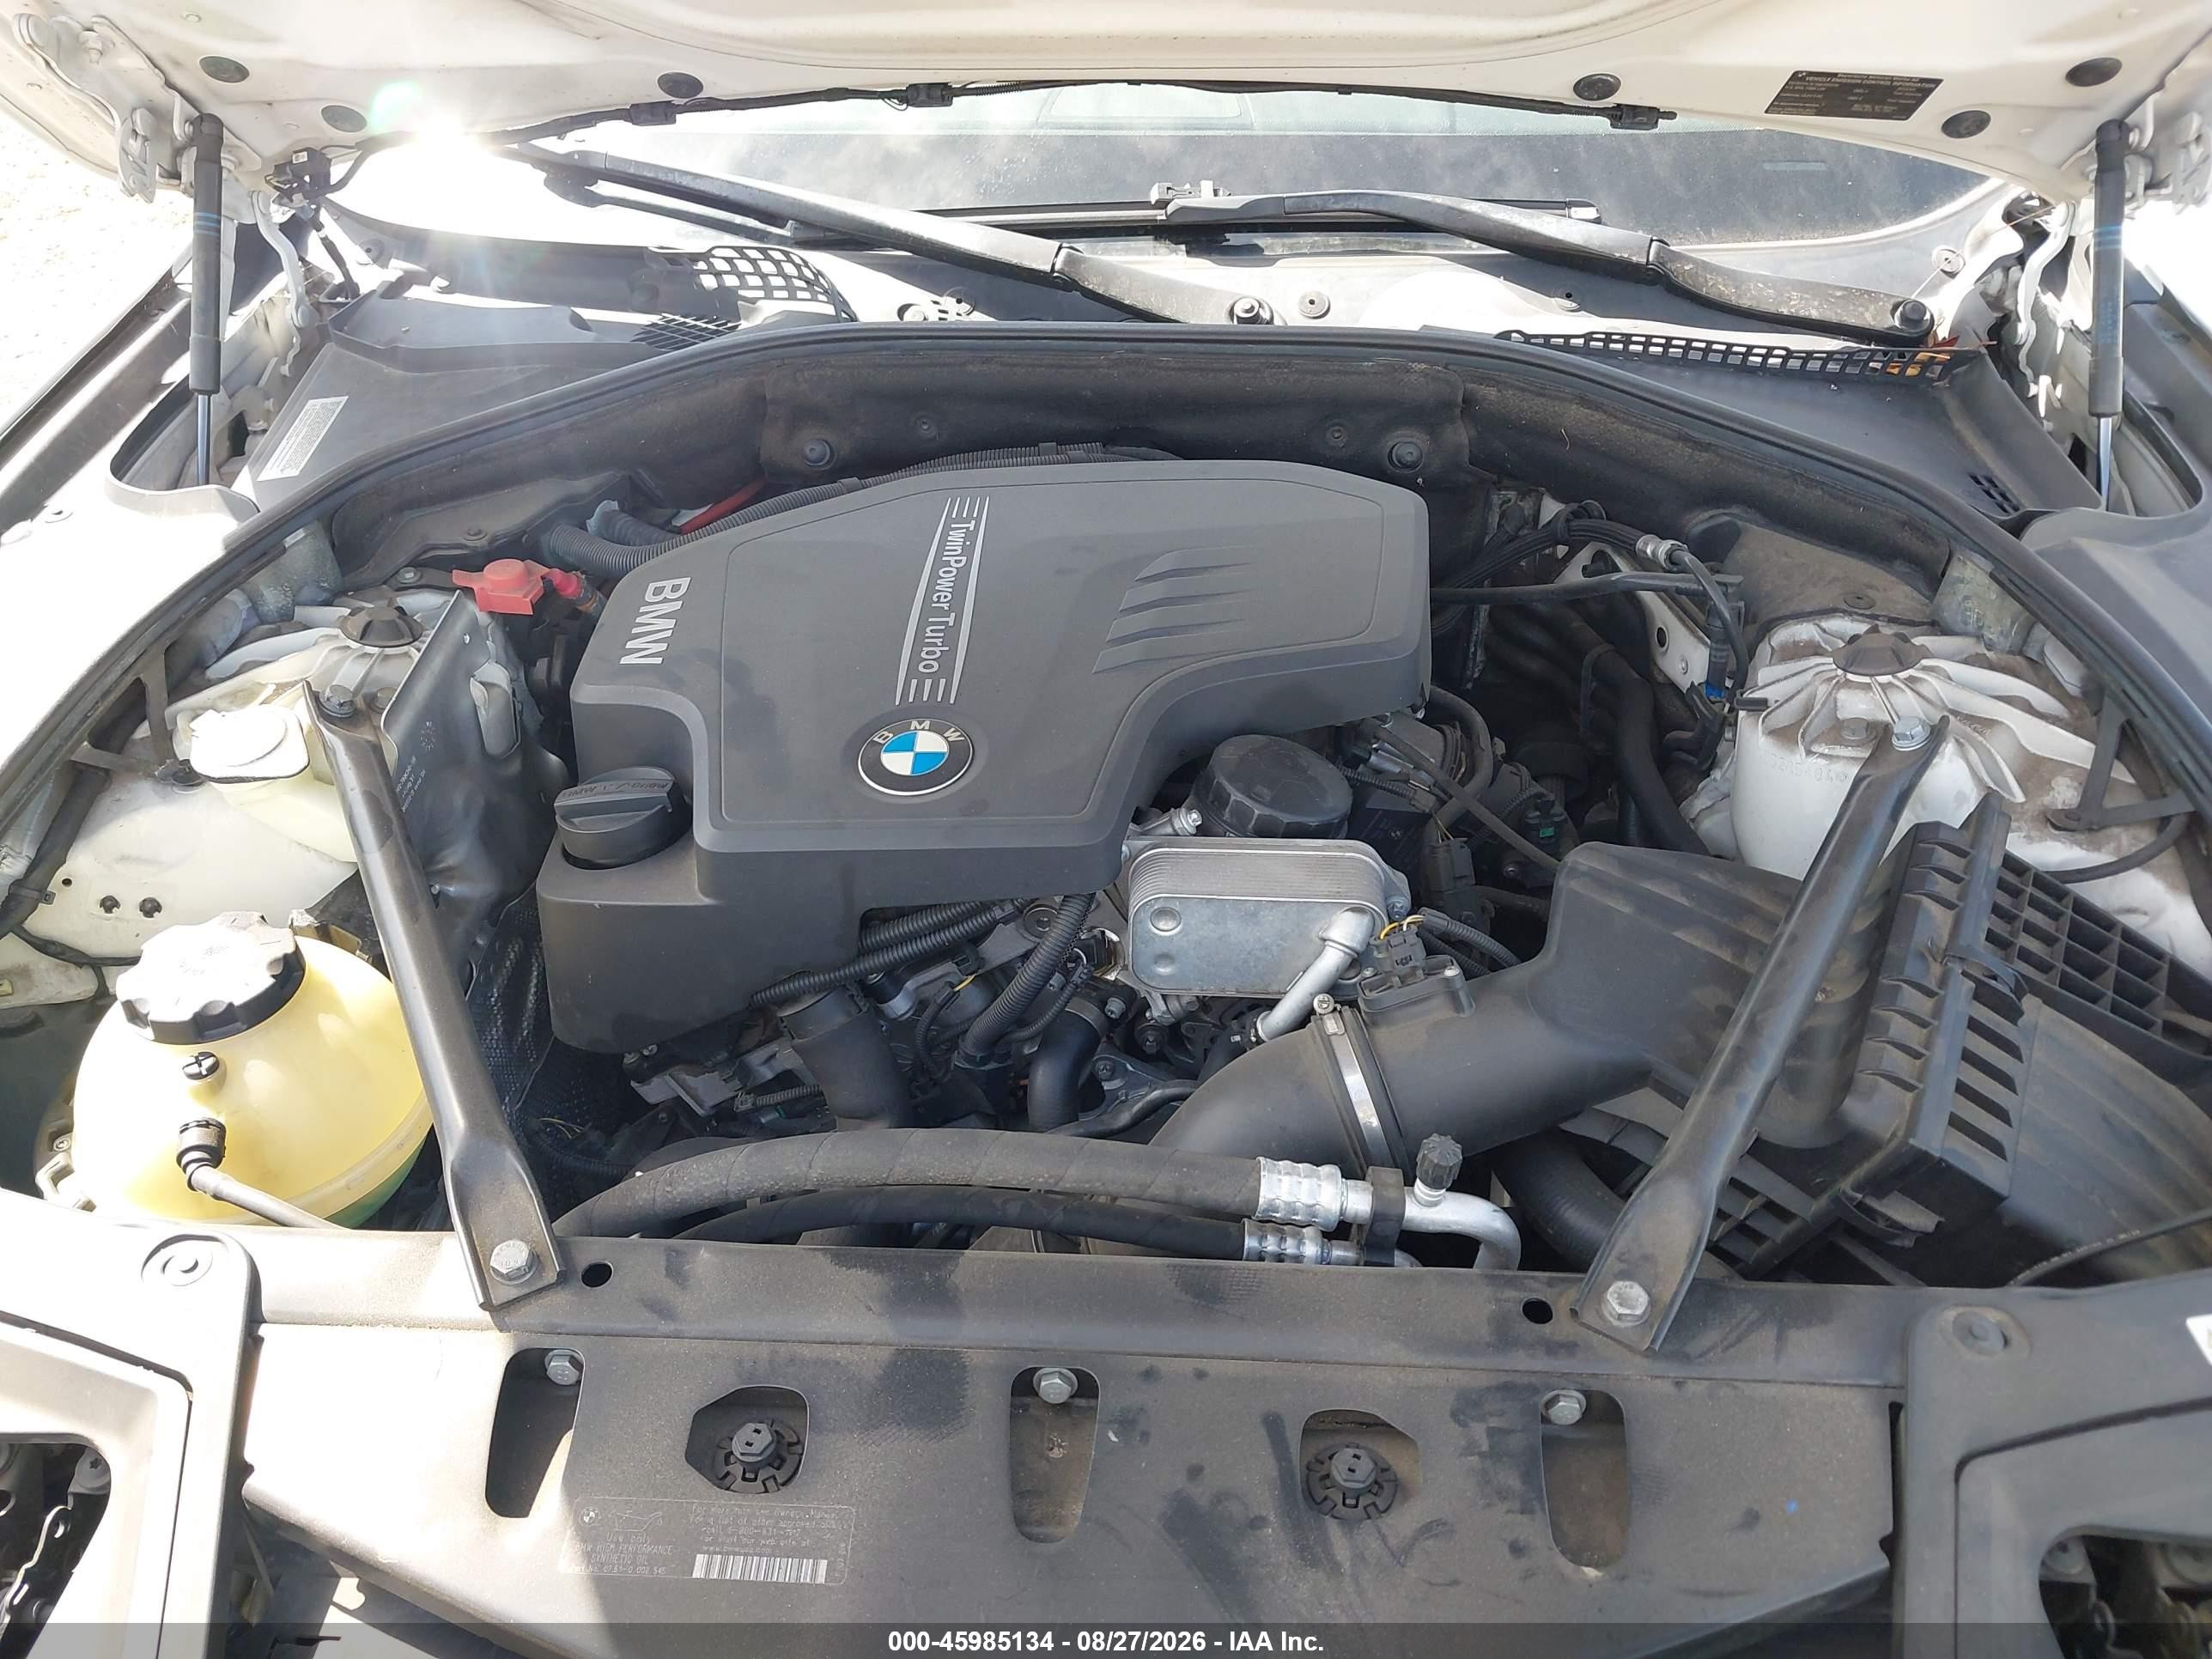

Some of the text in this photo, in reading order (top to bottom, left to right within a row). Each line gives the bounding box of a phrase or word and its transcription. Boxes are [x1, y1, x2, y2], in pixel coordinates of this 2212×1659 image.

[619, 576, 691, 665] BMW
[918, 519, 976, 674] TwinPower Turbo
[872, 719, 965, 744] BMW
[591, 1552, 634, 1564] SYNTHETIC
